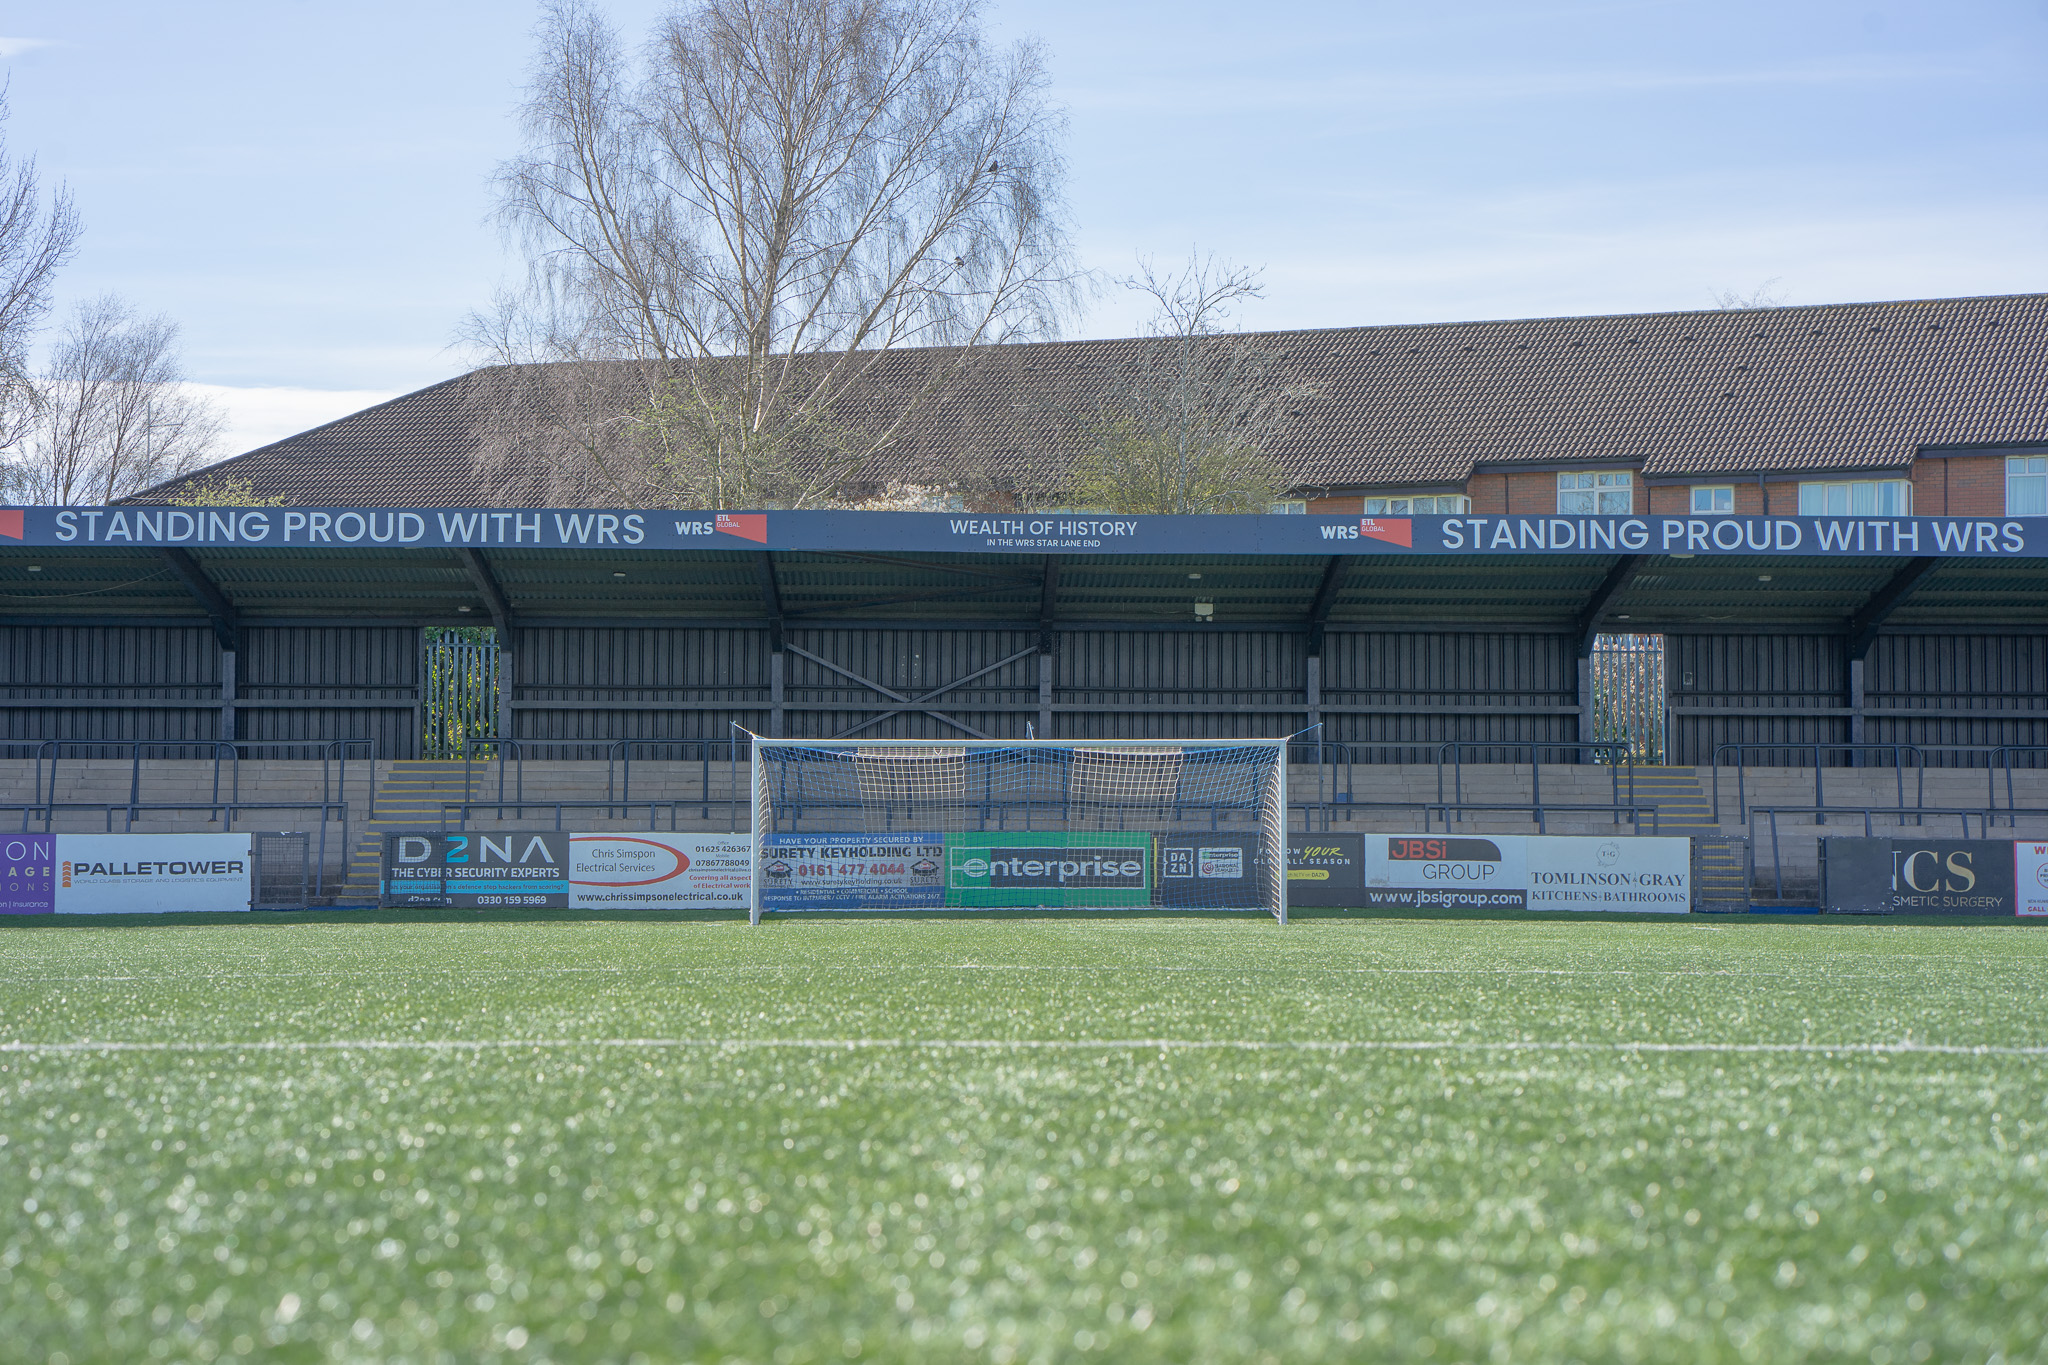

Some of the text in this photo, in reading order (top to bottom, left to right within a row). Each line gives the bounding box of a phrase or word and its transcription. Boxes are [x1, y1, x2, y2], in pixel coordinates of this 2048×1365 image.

[55, 511, 645, 544] STANDING PROUD WITH WRS
[675, 522, 714, 535] WRS
[950, 520, 1138, 536] WEALTH OF HISTORY
[1320, 526, 1358, 540] WRS
[1442, 519, 2024, 552] STANDING PROUD WITH WRS
[1015, 539, 1034, 547] WRS
[1036, 539, 1058, 548] STAR
[0, 841, 49, 860] ON
[398, 836, 555, 863] D2NA
[592, 848, 656, 861] Chris Simspon
[760, 846, 942, 858] SURETY KEYHOLDING LTD
[1392, 840, 1447, 859] JBSi
[2034, 846, 2048, 855] W
[1170, 852, 1188, 862] DA
[0, 866, 50, 876] AGE
[74, 861, 244, 876] PALLETOWER
[392, 868, 414, 878] THE
[454, 868, 508, 878] SECURITY
[511, 868, 560, 878] EXPERTS
[576, 862, 656, 872] Electrical Services
[798, 863, 906, 876] 0161 477 4044
[963, 856, 1142, 882] enterprise
[1170, 863, 1187, 873] ZN
[1422, 864, 1495, 880] GROUP
[1892, 850, 1976, 893] CS
[1531, 872, 1631, 886] TOMLINSON
[1639, 874, 1685, 887] GRAY
[478, 896, 547, 904] 0330 159 5969
[577, 892, 743, 902] www.chrissimpsonelectrical.co.uk
[1370, 891, 1523, 908] www.jbsigroup.com
[1532, 890, 1598, 901] KITCHENS
[1604, 892, 1686, 902] BATHROOMS
[1892, 896, 2003, 908] SMETIC SURGERY
